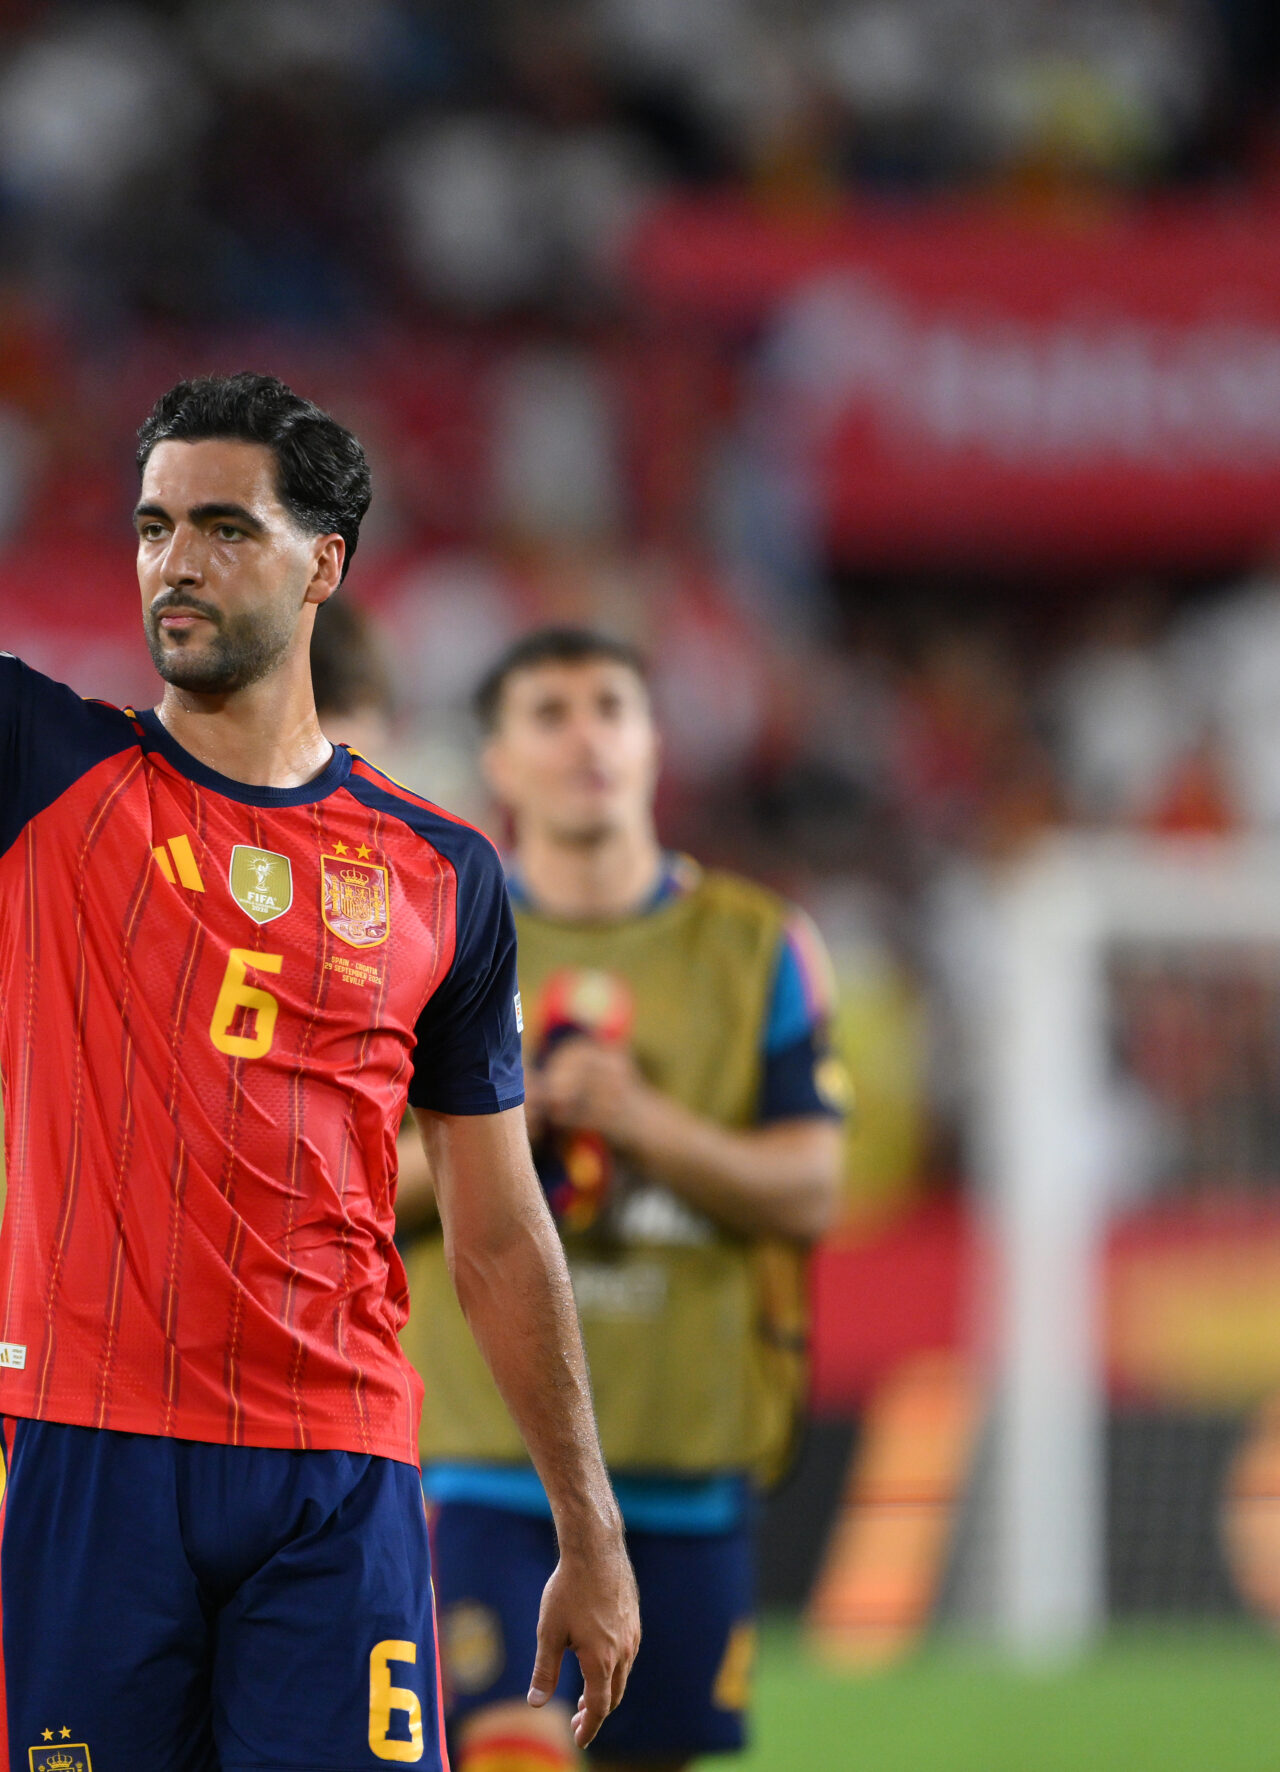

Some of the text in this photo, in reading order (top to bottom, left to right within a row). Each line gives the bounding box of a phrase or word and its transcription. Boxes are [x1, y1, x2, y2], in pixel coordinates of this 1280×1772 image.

[247, 891, 274, 906] FIFA
[324, 961, 333, 970] 29
[334, 964, 368, 980] SEPTEMBER
[331, 955, 350, 967] SPAIN
[355, 962, 378, 976] CROATIA
[342, 974, 365, 987] SEVILLE
[209, 948, 284, 1060] 6
[368, 1639, 425, 1763] 6
